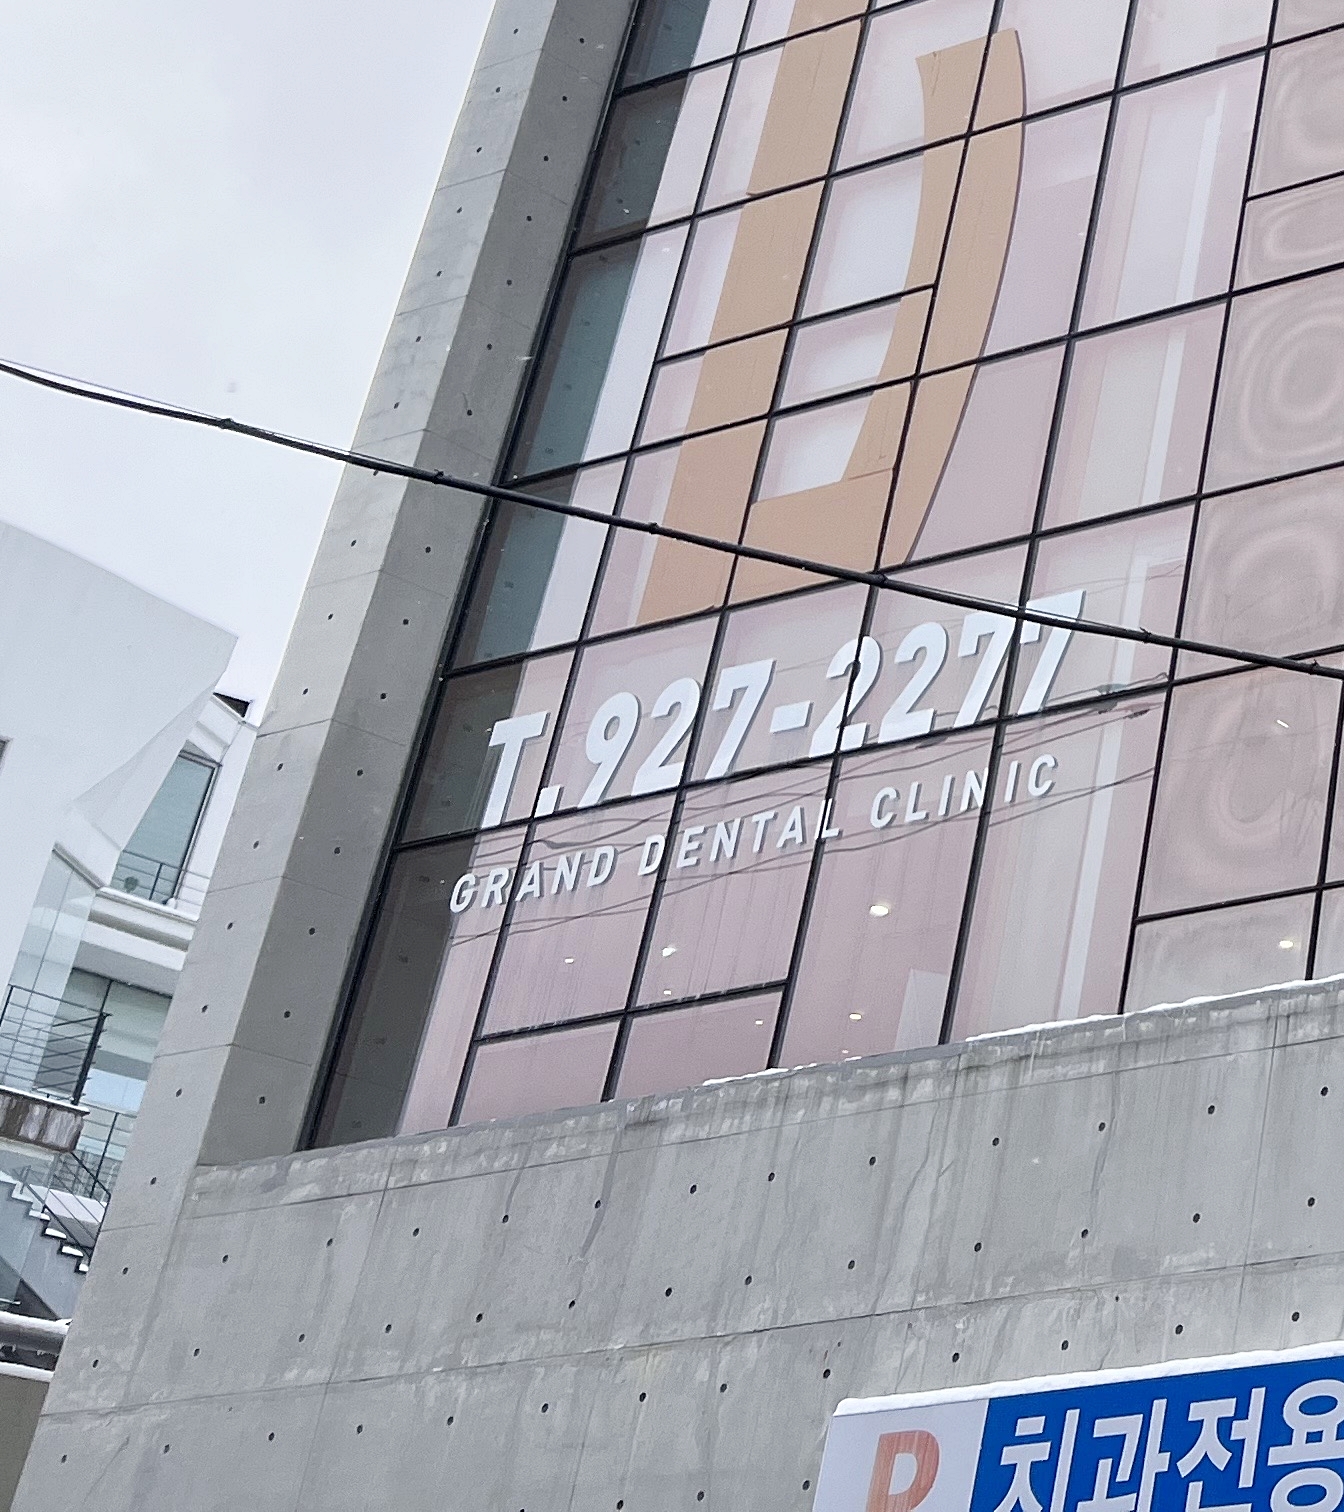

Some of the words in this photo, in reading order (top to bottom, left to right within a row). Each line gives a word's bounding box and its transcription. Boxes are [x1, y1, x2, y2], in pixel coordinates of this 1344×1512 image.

[480, 589, 1087, 830] T.927-2277
[448, 843, 617, 915] GRAND
[637, 798, 843, 879] DENTAL
[868, 753, 1058, 830] CLINIC
